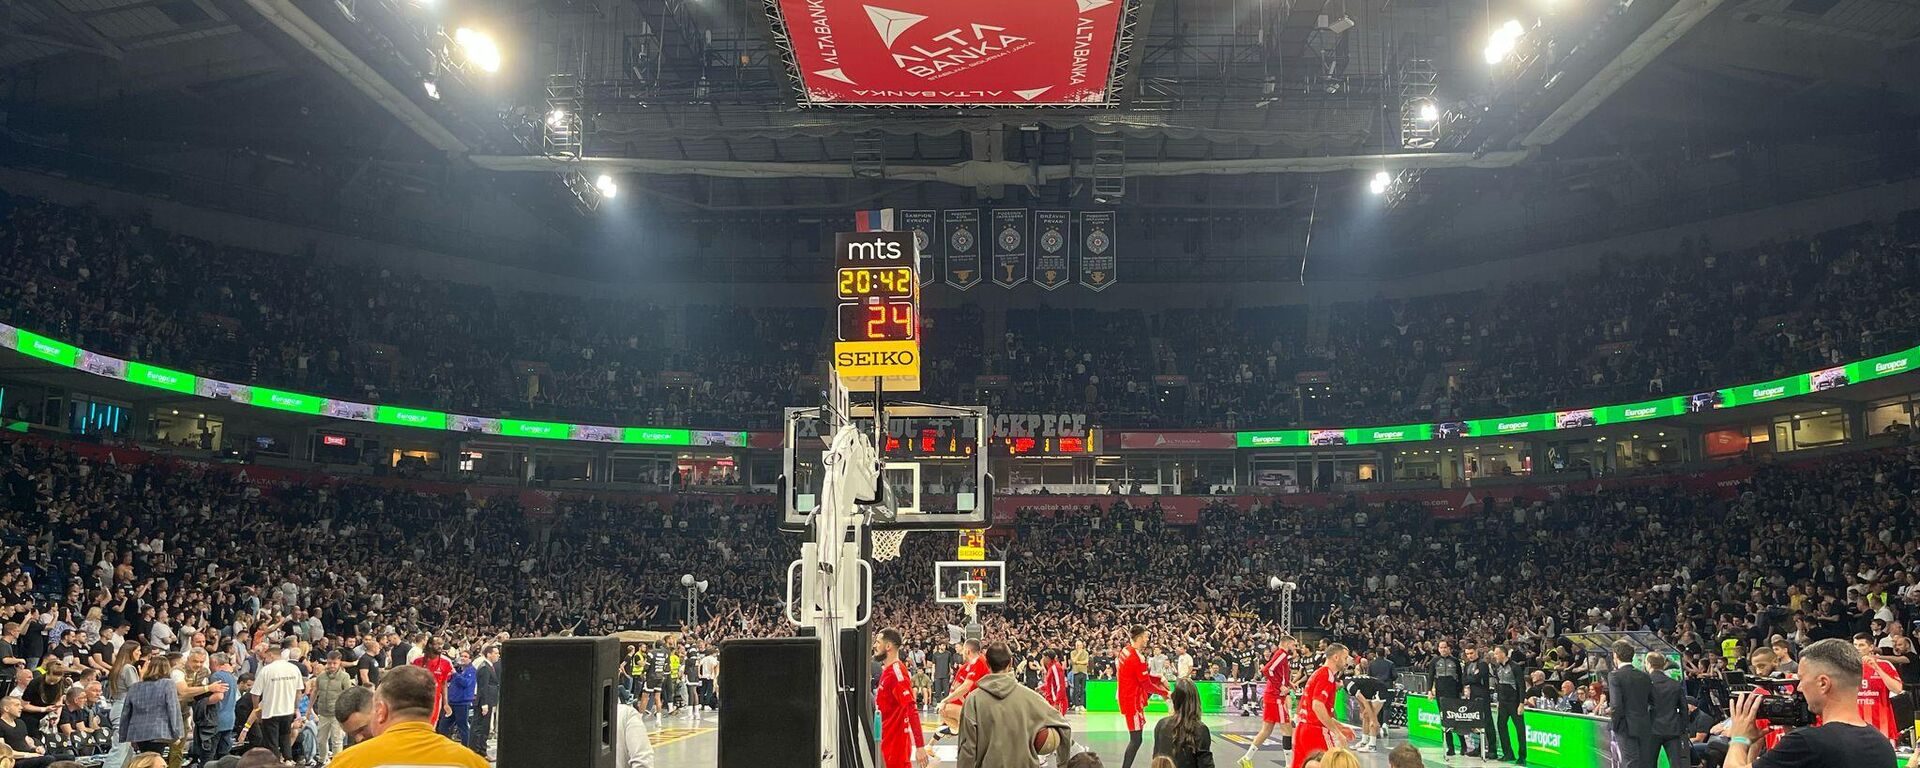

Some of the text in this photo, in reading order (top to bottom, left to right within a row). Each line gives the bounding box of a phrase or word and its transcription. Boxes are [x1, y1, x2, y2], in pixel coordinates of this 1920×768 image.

[906, 34, 1027, 78] BANKA
[848, 238, 901, 260] mts
[840, 270, 910, 294] 20:42
[868, 306, 911, 338] 24
[838, 351, 914, 367] SEIKO
[1875, 358, 1908, 371] Europcar
[1753, 386, 1785, 397] Europcar
[1624, 407, 1657, 417] Europcar
[1497, 420, 1528, 430] Europcar
[1252, 435, 1282, 444] Europcar
[1373, 431, 1404, 440] Europcar
[968, 535, 985, 547] 24
[1418, 708, 1441, 724] Europca
[1446, 710, 1481, 720] SPALDING
[1525, 726, 1562, 748] Europcar
